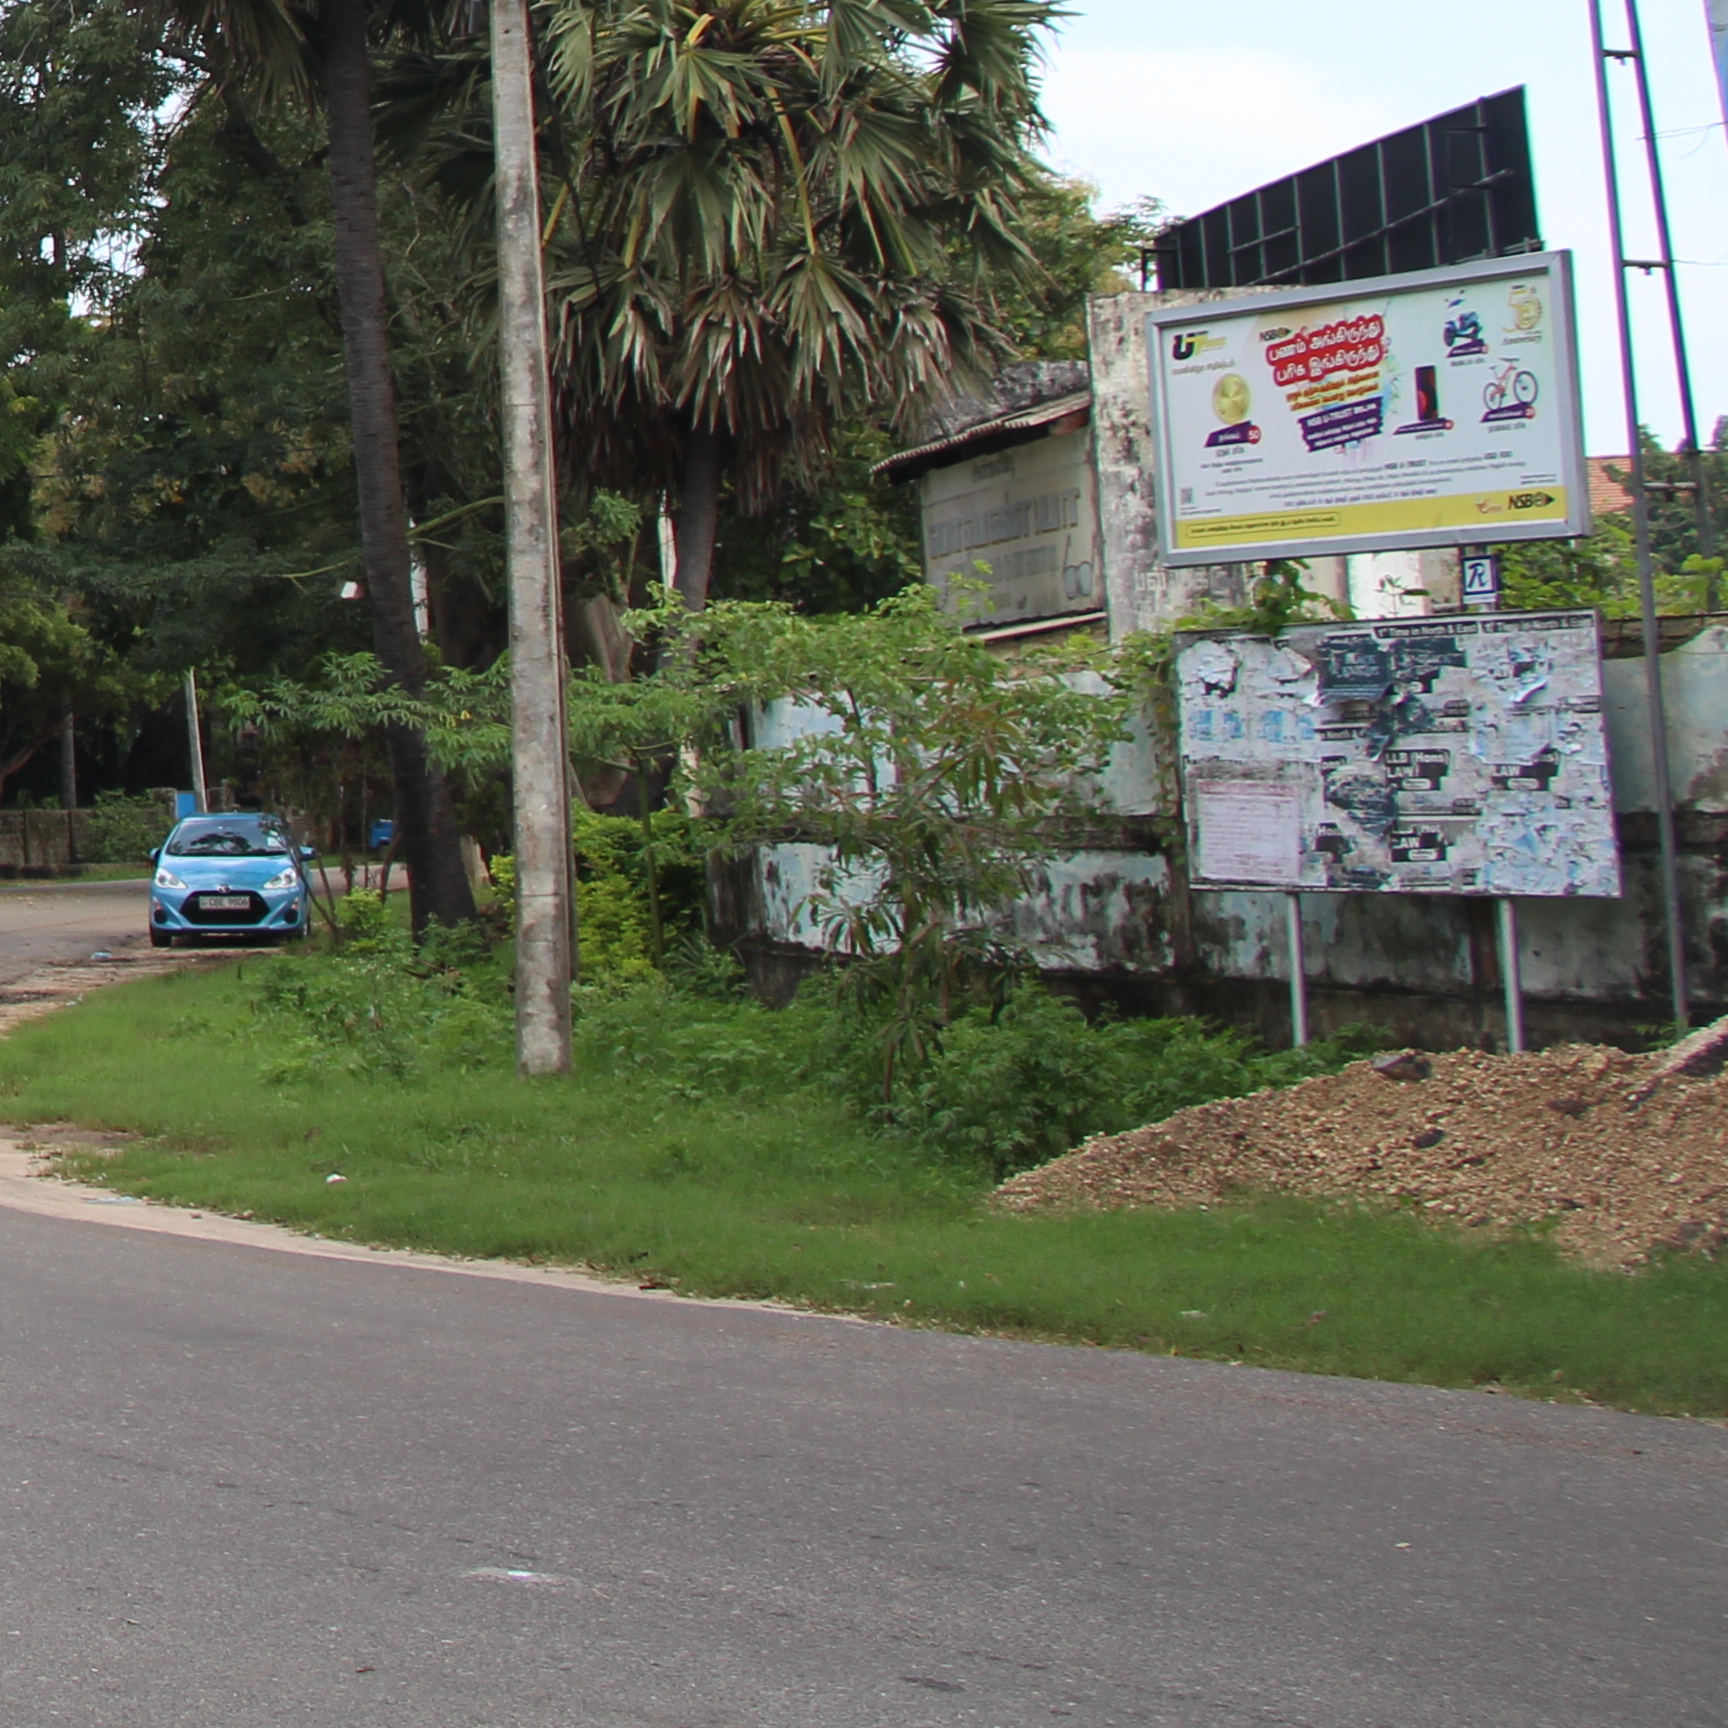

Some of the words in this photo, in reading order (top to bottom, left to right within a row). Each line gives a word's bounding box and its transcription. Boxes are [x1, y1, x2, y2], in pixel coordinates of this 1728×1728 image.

[1268, 338, 1307, 361] பணம்
[1309, 320, 1381, 350] அங்கிருந்து
[1248, 430, 1259, 440] 50
[1508, 494, 1533, 510] NSB
[1389, 626, 1409, 637] Time
[1411, 626, 1420, 636] in
[1421, 624, 1445, 635] North
[1447, 623, 1454, 634] &
[1456, 622, 1477, 633] East
[1322, 758, 1345, 770] ons)
[1385, 752, 1408, 764] LLB
[1411, 752, 1448, 764] (Hons)
[1387, 766, 1417, 778] LAW
